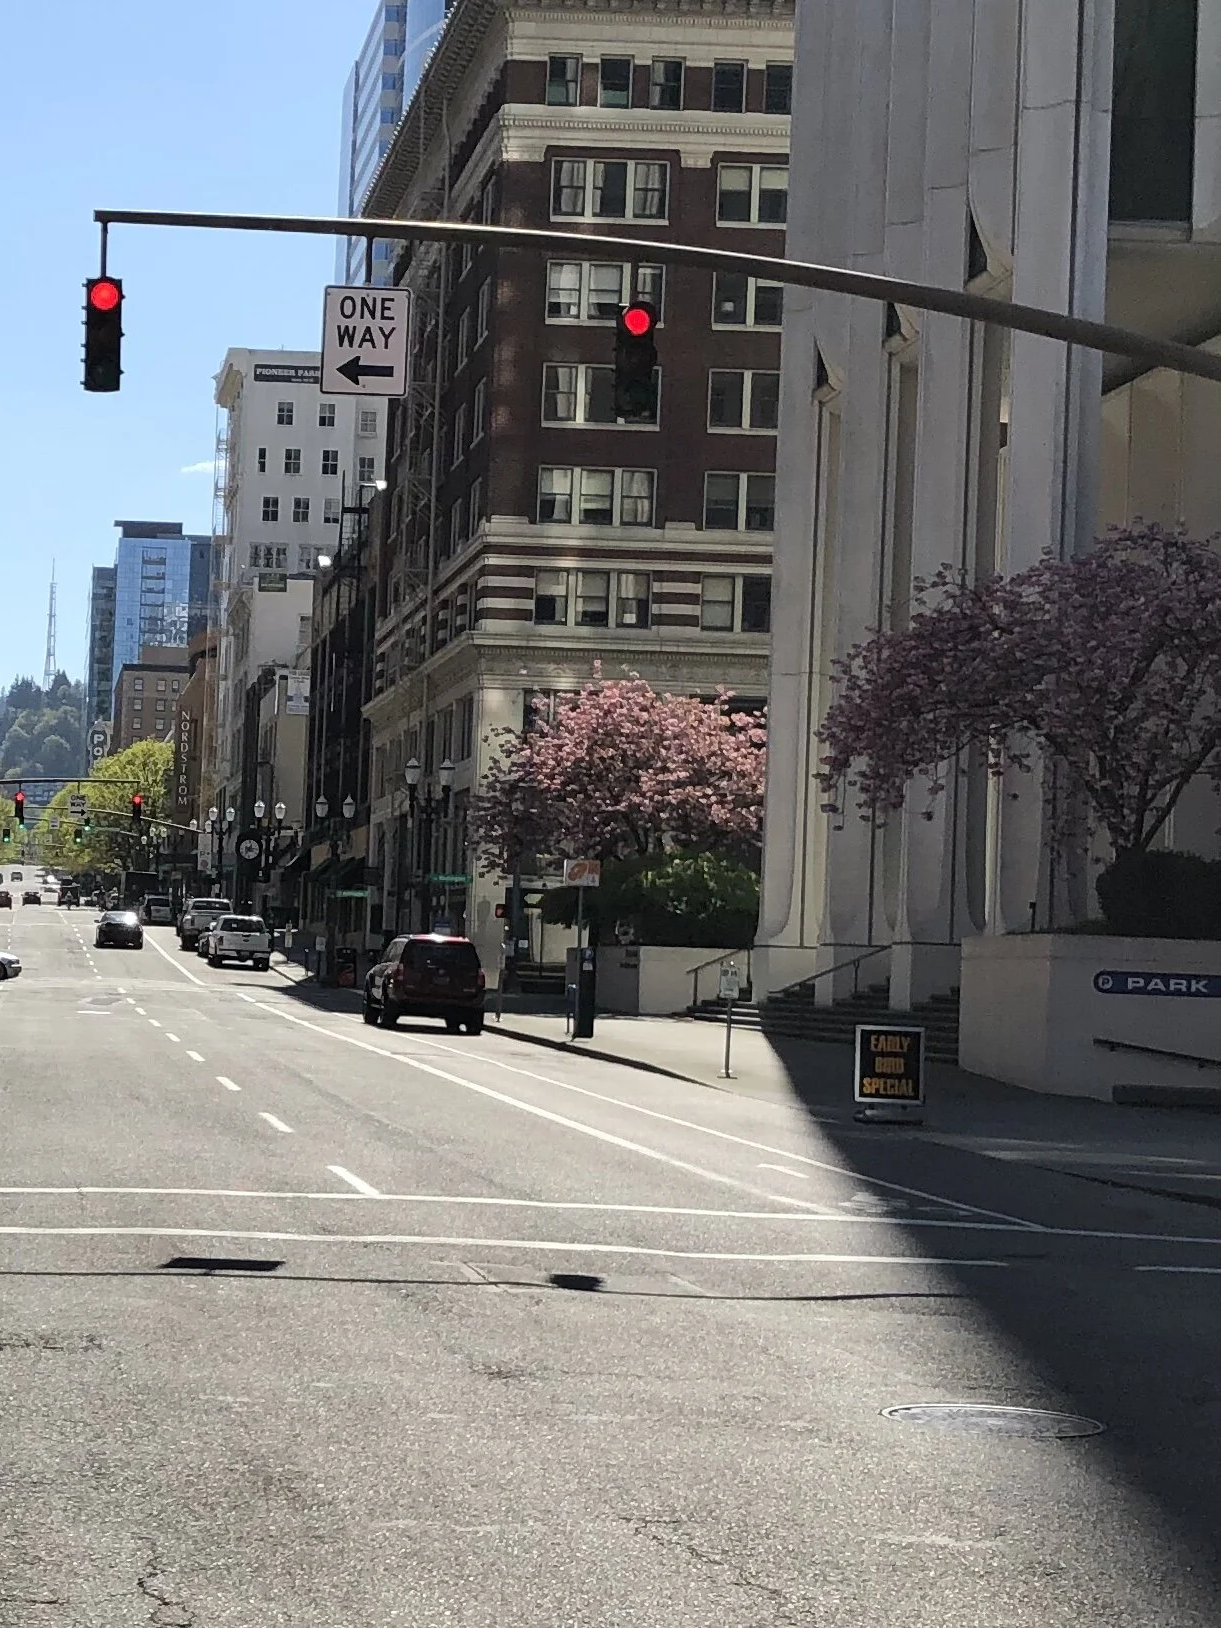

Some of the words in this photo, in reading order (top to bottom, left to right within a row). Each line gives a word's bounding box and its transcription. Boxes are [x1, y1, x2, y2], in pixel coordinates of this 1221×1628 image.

[340, 295, 395, 320] ONE
[337, 325, 396, 349] WAY
[256, 368, 296, 376] PIONEER
[178, 710, 190, 806] NORDSTROM
[1127, 977, 1208, 993] PARK
[870, 1034, 911, 1052] EARLY
[862, 1077, 915, 1096] SPECIAL
